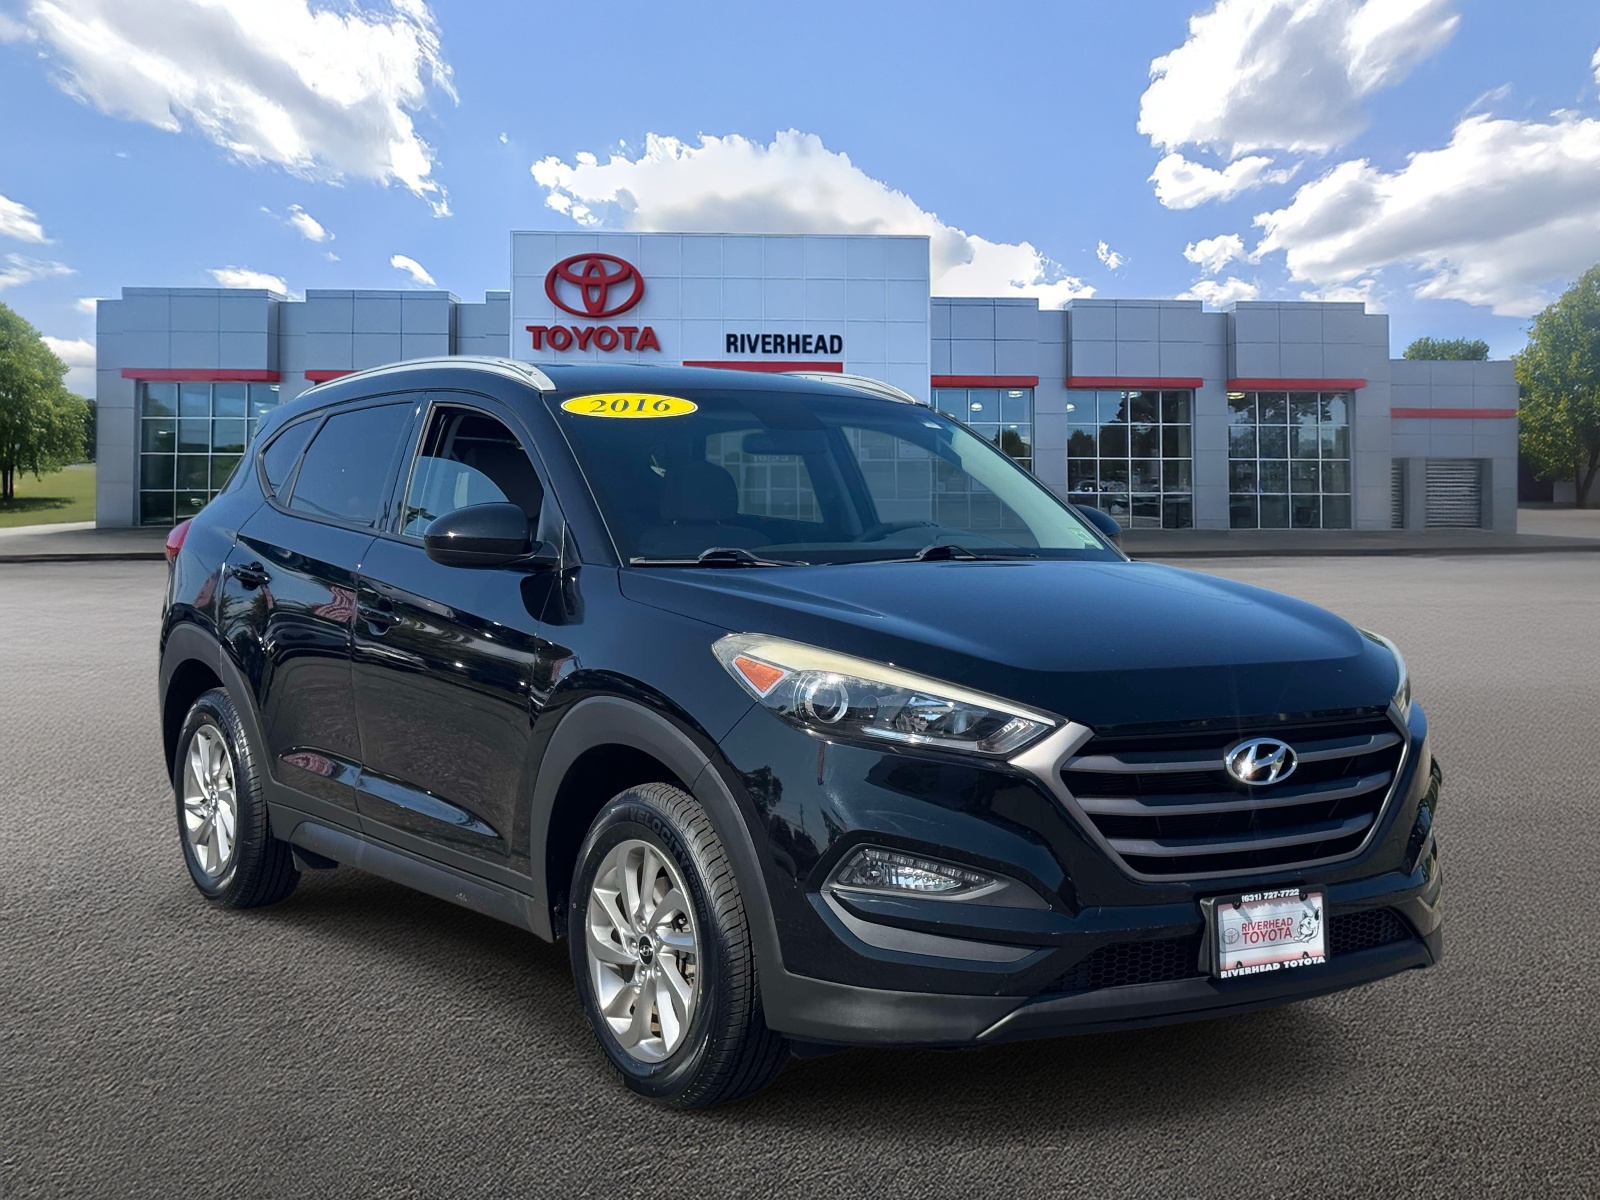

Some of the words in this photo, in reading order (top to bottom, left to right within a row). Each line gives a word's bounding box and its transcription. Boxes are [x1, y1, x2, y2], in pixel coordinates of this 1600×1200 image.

[525, 325, 660, 351] TOYOTA
[726, 333, 843, 354] RIVERHEAD
[589, 398, 671, 412] 2016
[1241, 893, 1262, 903] (631)
[1263, 888, 1300, 899] 727-7722
[1241, 917, 1294, 933] RIVERHEAD
[1241, 926, 1293, 945] TOYOTA
[1220, 961, 1281, 979] RIVERHEAD
[1283, 955, 1326, 969] TOYOTA
